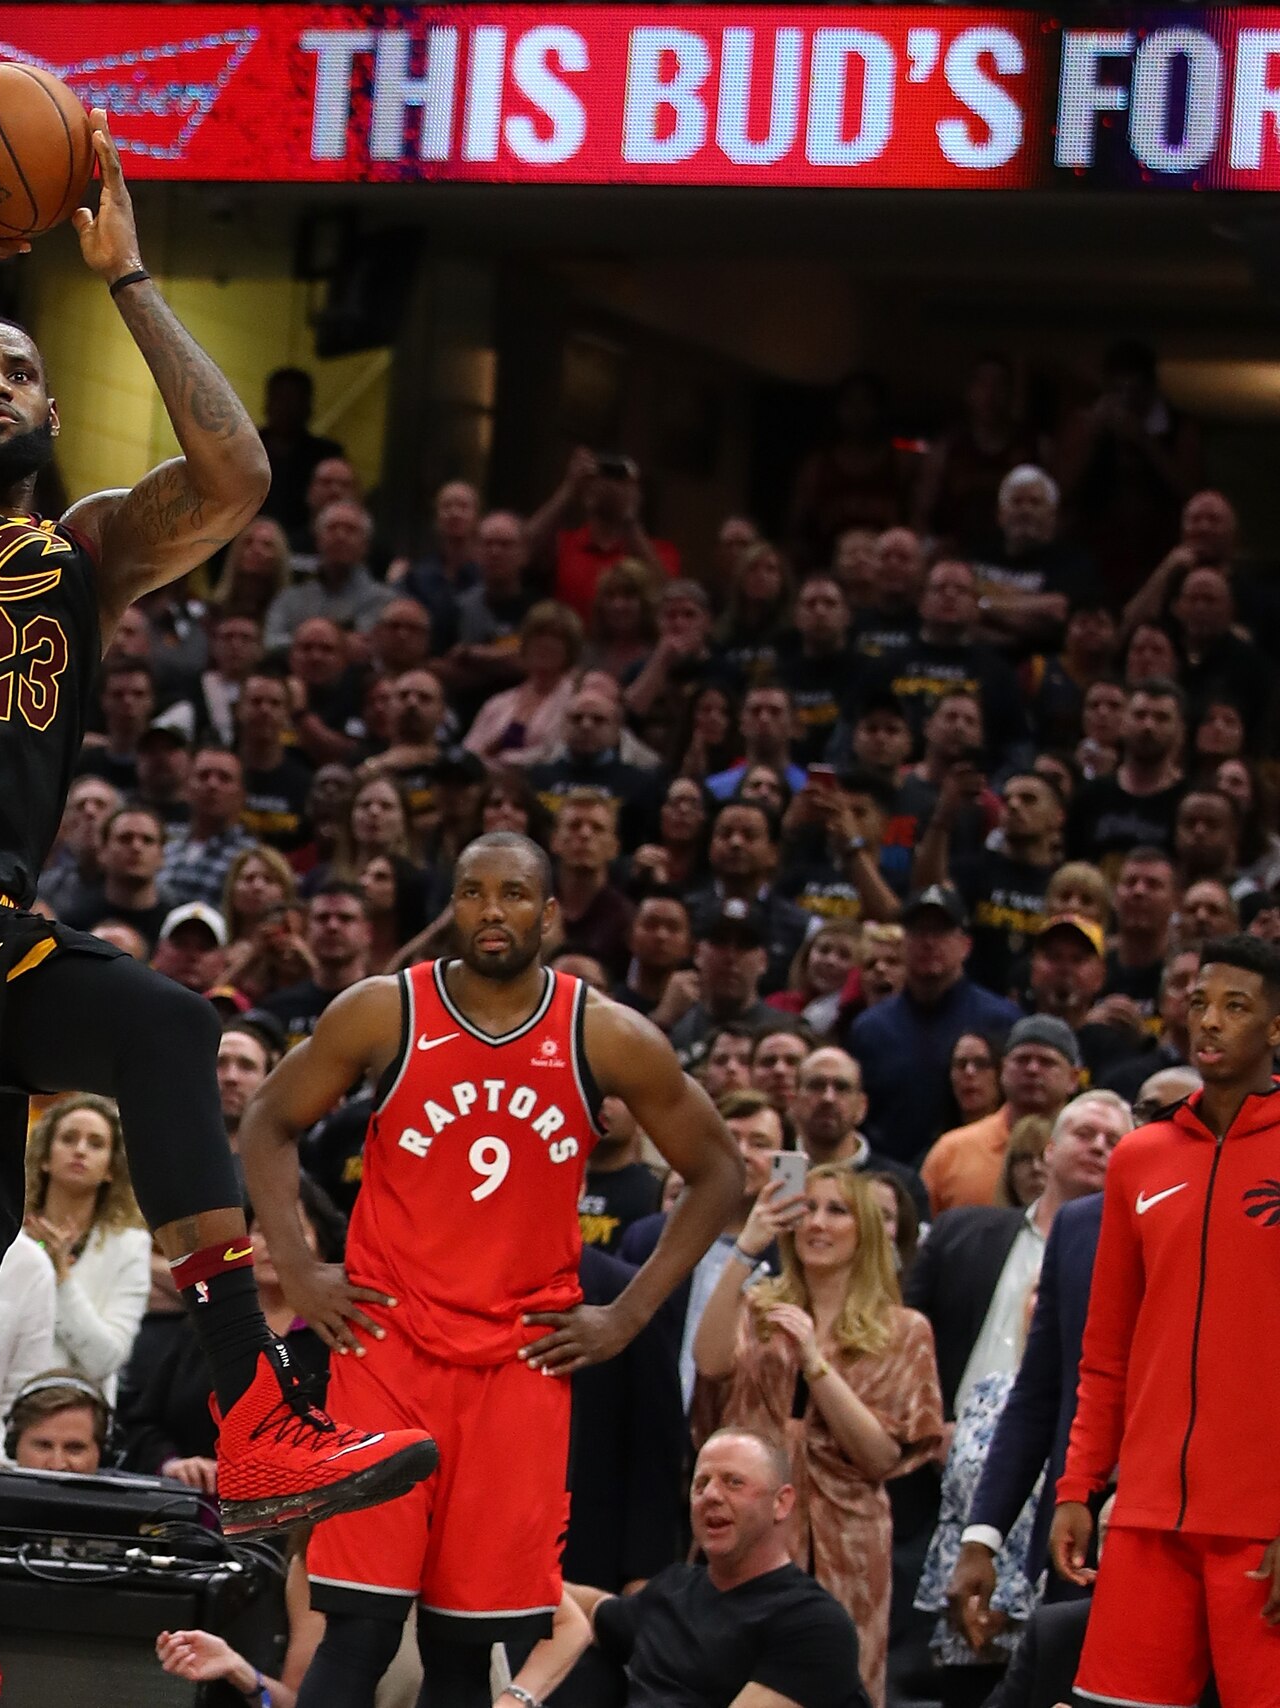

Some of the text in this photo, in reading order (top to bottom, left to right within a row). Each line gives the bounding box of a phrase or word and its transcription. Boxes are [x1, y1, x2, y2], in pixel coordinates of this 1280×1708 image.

[299, 24, 590, 167] THIS
[621, 25, 1026, 170] BUD'S
[397, 1079, 580, 1165] RAPTORS
[468, 1135, 511, 1203] 9
